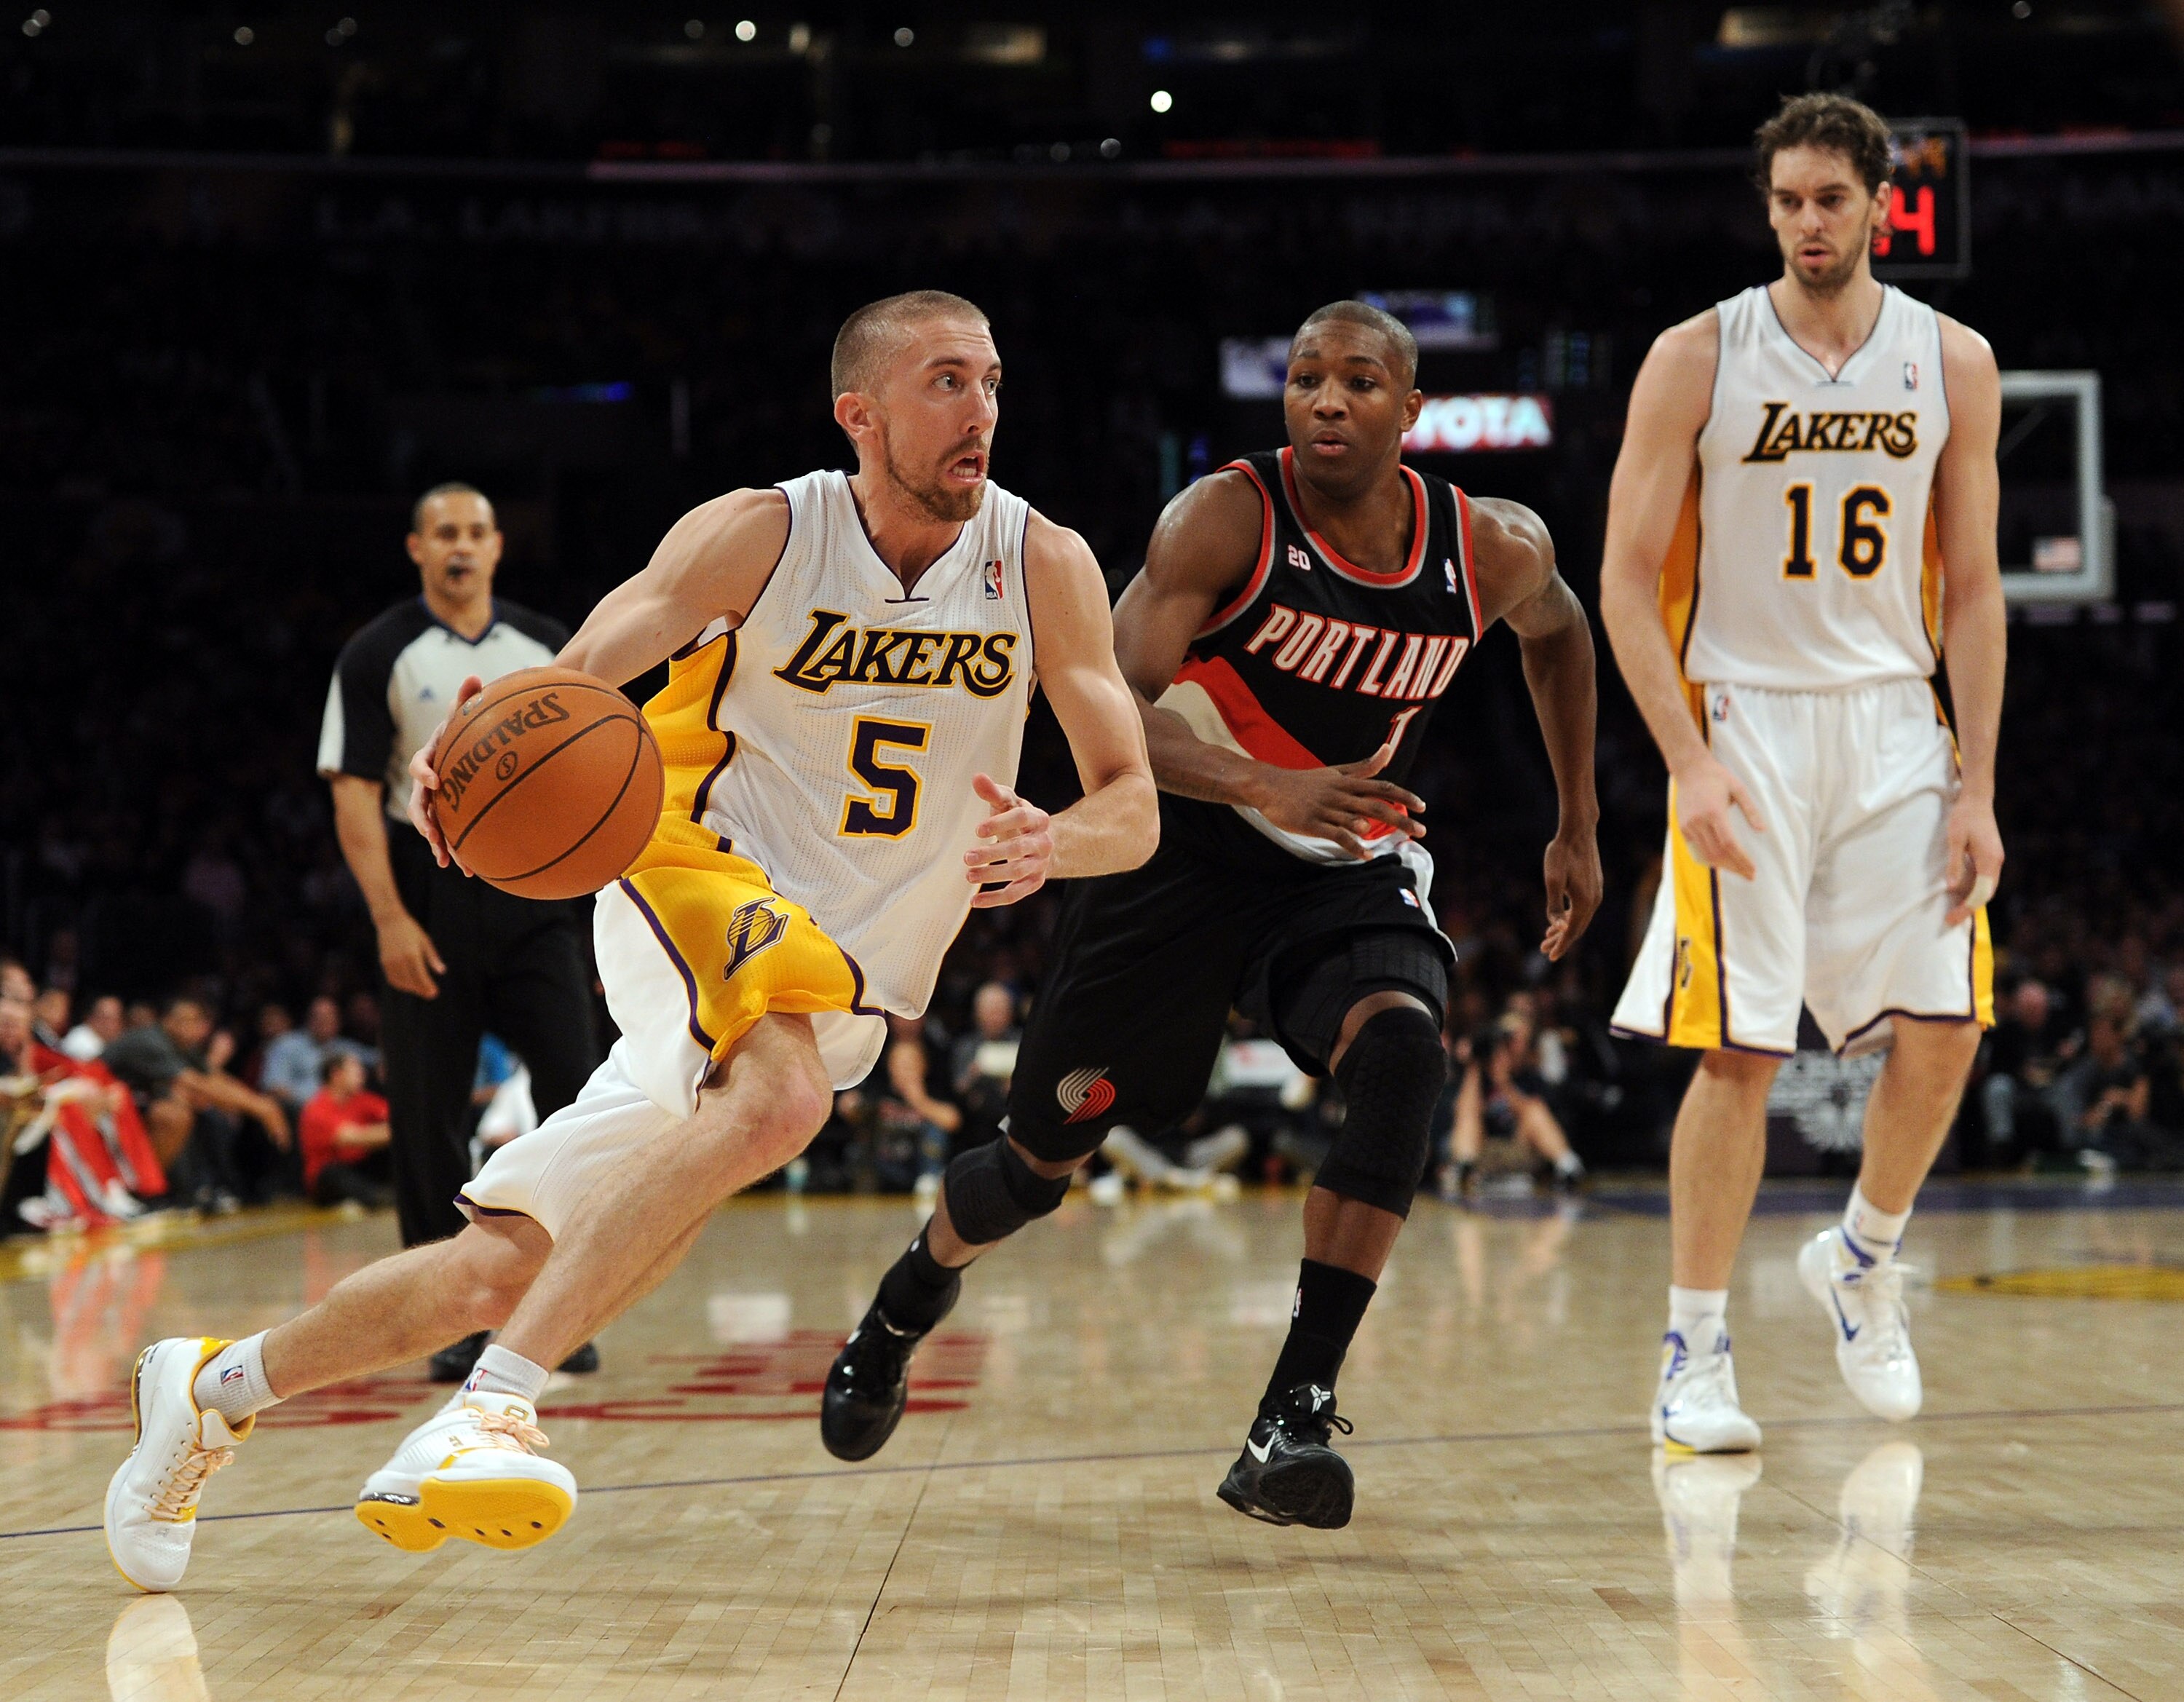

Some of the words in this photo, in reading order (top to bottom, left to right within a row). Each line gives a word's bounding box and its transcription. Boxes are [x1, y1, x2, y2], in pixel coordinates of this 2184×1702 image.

[1741, 402, 1919, 464] LAKERS
[1288, 544, 1311, 571] 20
[1783, 483, 1893, 580] 16
[770, 608, 1020, 700] LAKERS
[1244, 603, 1470, 700] PORTLAND
[438, 692, 570, 813] SPALDING
[837, 715, 932, 841] 5
[1383, 705, 1423, 768] 1
